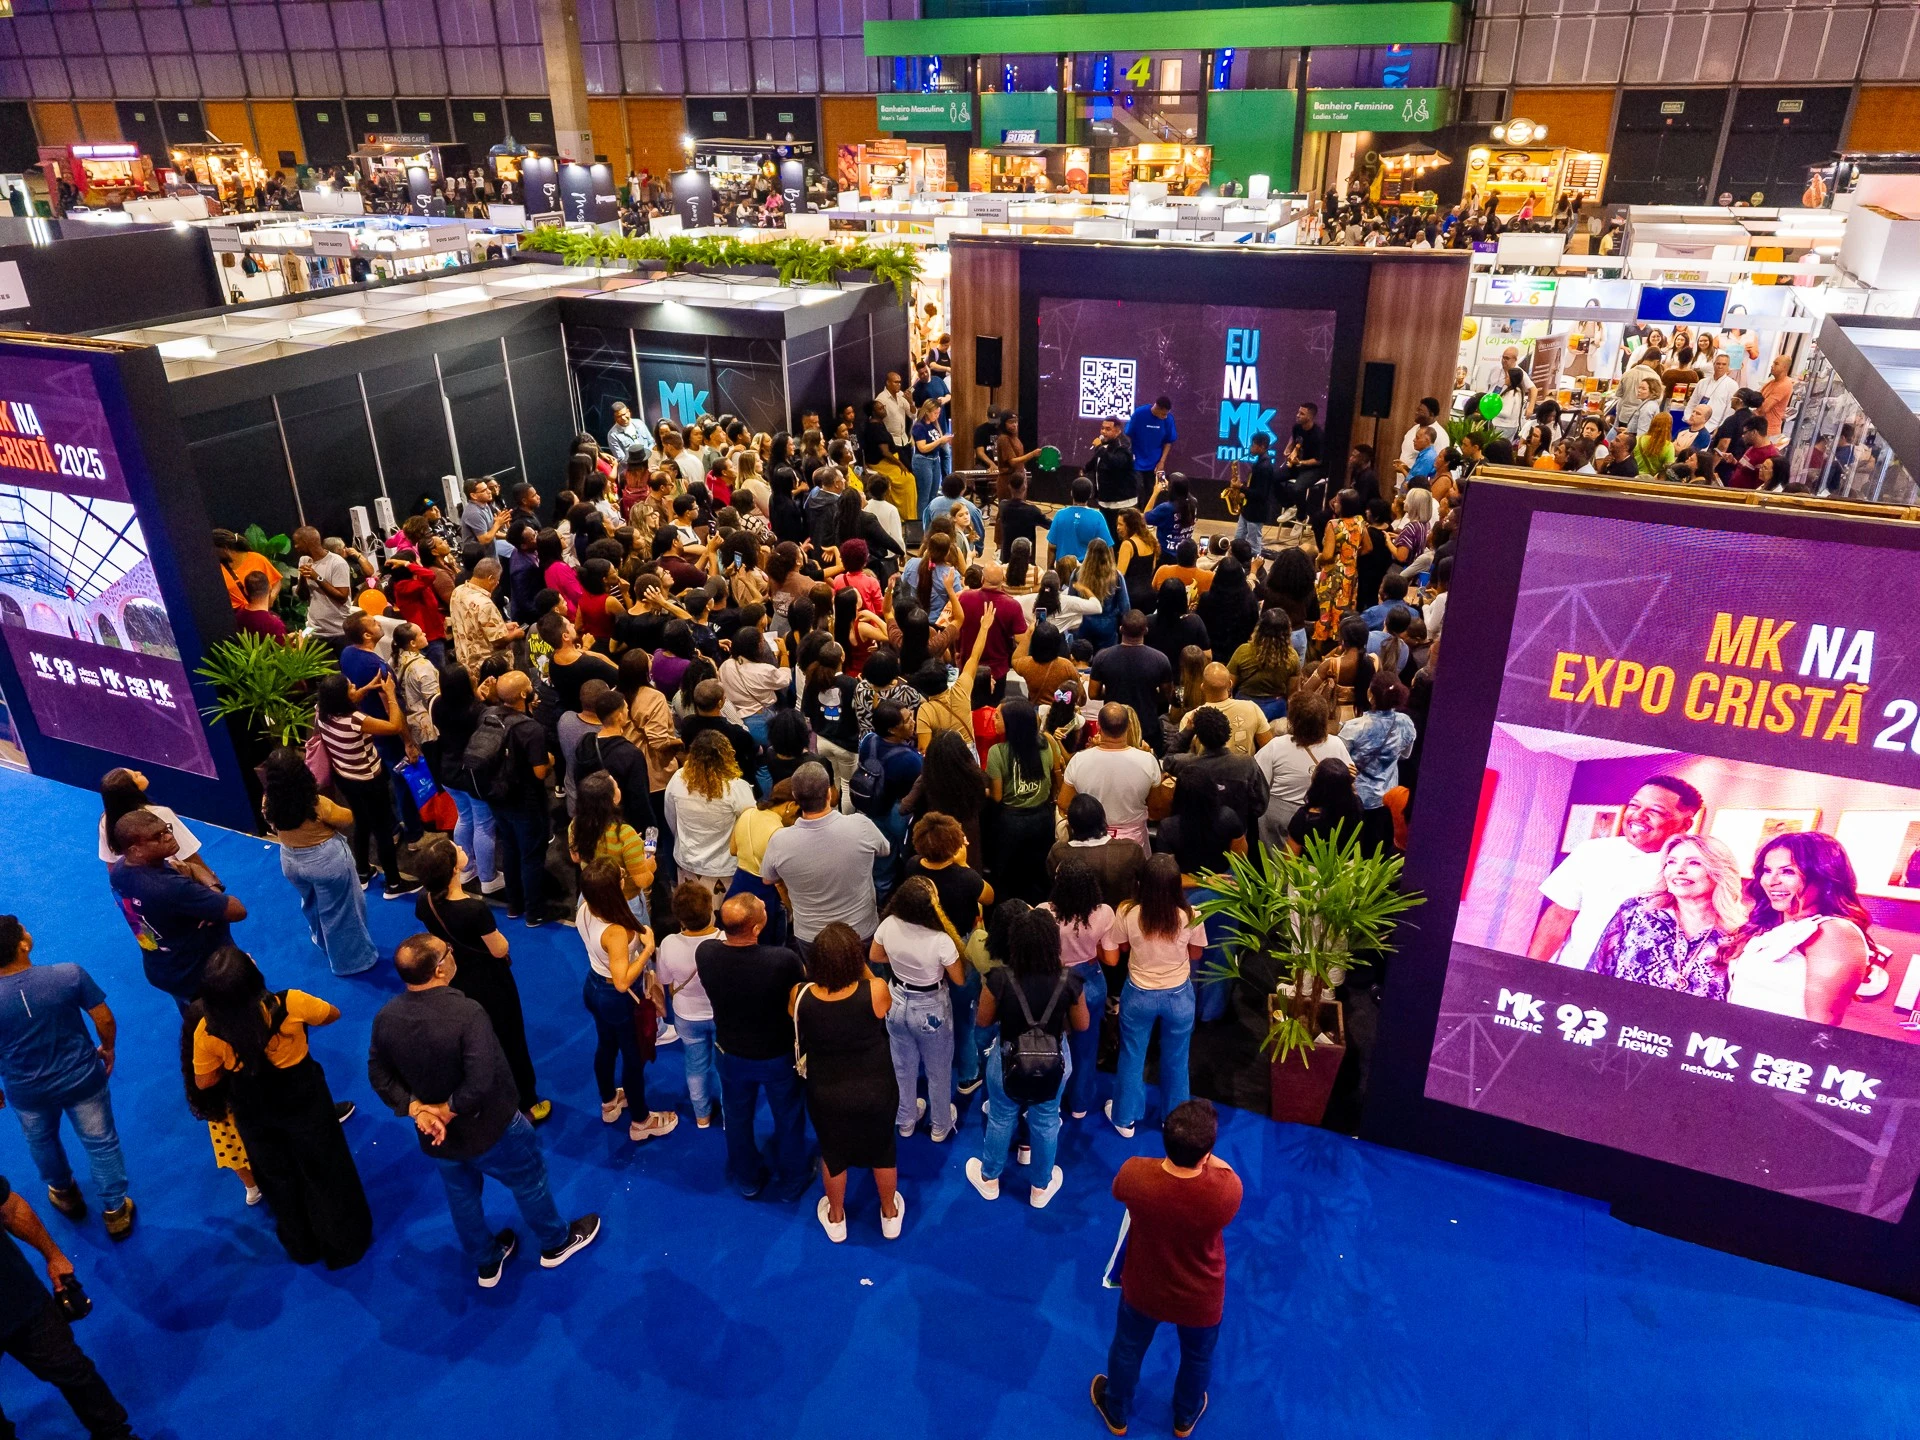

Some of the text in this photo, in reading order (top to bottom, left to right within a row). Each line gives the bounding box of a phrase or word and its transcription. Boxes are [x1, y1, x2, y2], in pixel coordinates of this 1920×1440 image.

[1126, 56, 1151, 87] 4
[880, 104, 945, 113] Banheiro Masculino
[1313, 101, 1394, 110] Banheiro Feminino
[1226, 328, 1260, 364] EU
[1223, 365, 1259, 400] NA
[10, 402, 44, 435] NA
[659, 381, 709, 427] MK
[1219, 401, 1278, 449] MK
[54, 443, 106, 480] 2025
[30, 651, 53, 672] MK
[1705, 612, 1876, 685] MK NA
[53, 657, 76, 680] 93
[99, 667, 124, 689] MK
[149, 678, 172, 701] MK
[1548, 651, 1676, 715] EXPO
[1684, 672, 1870, 744] CRISTÃ
[1497, 988, 1545, 1022] MK
[1493, 1014, 1543, 1034] music
[1556, 1003, 1609, 1040] 93
[1563, 1029, 1593, 1046] FM
[1617, 1037, 1669, 1058] news
[1685, 1031, 1742, 1069] MK
[1680, 1062, 1735, 1082] network
[1750, 1068, 1811, 1094] CRE
[1821, 1065, 1882, 1101] MK
[1816, 1093, 1873, 1114] BOOKS
